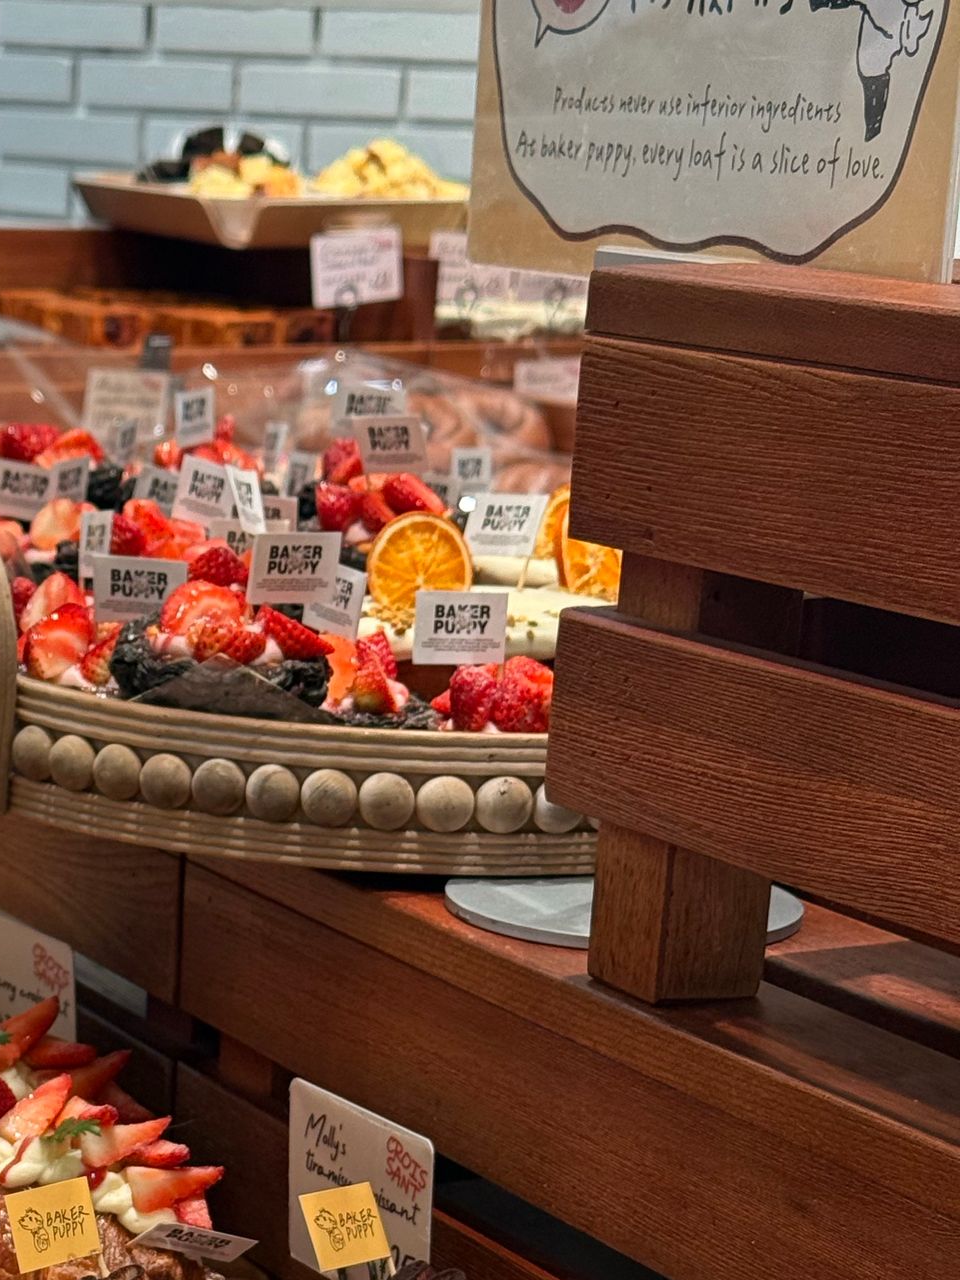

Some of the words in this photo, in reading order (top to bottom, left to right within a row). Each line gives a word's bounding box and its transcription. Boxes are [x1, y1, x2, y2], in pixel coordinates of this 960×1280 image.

[553, 86, 614, 115] Products
[619, 94, 654, 113] never
[659, 95, 682, 116] use
[686, 84, 745, 127] inferior
[751, 93, 842, 133] ingredients
[541, 133, 582, 160] baker
[642, 142, 684, 181] every
[688, 131, 726, 181] loaf
[731, 144, 745, 172] is
[751, 154, 763, 173] a
[770, 143, 810, 175] slice
[817, 137, 841, 189] of
[269, 545, 323, 560] BAKER
[110, 568, 168, 586] BAKER
[435, 604, 491, 619] BAKER
[304, 1113, 346, 1161] Molly's
[386, 1136, 428, 1190] CROIS
[385, 1157, 423, 1200] SANT
[46, 1205, 90, 1227] BAKER
[338, 1208, 377, 1228] BAKER
[374, 1188, 421, 1225] issant
[53, 1218, 85, 1241] PUPPY
[346, 1223, 375, 1242] PUPPY
